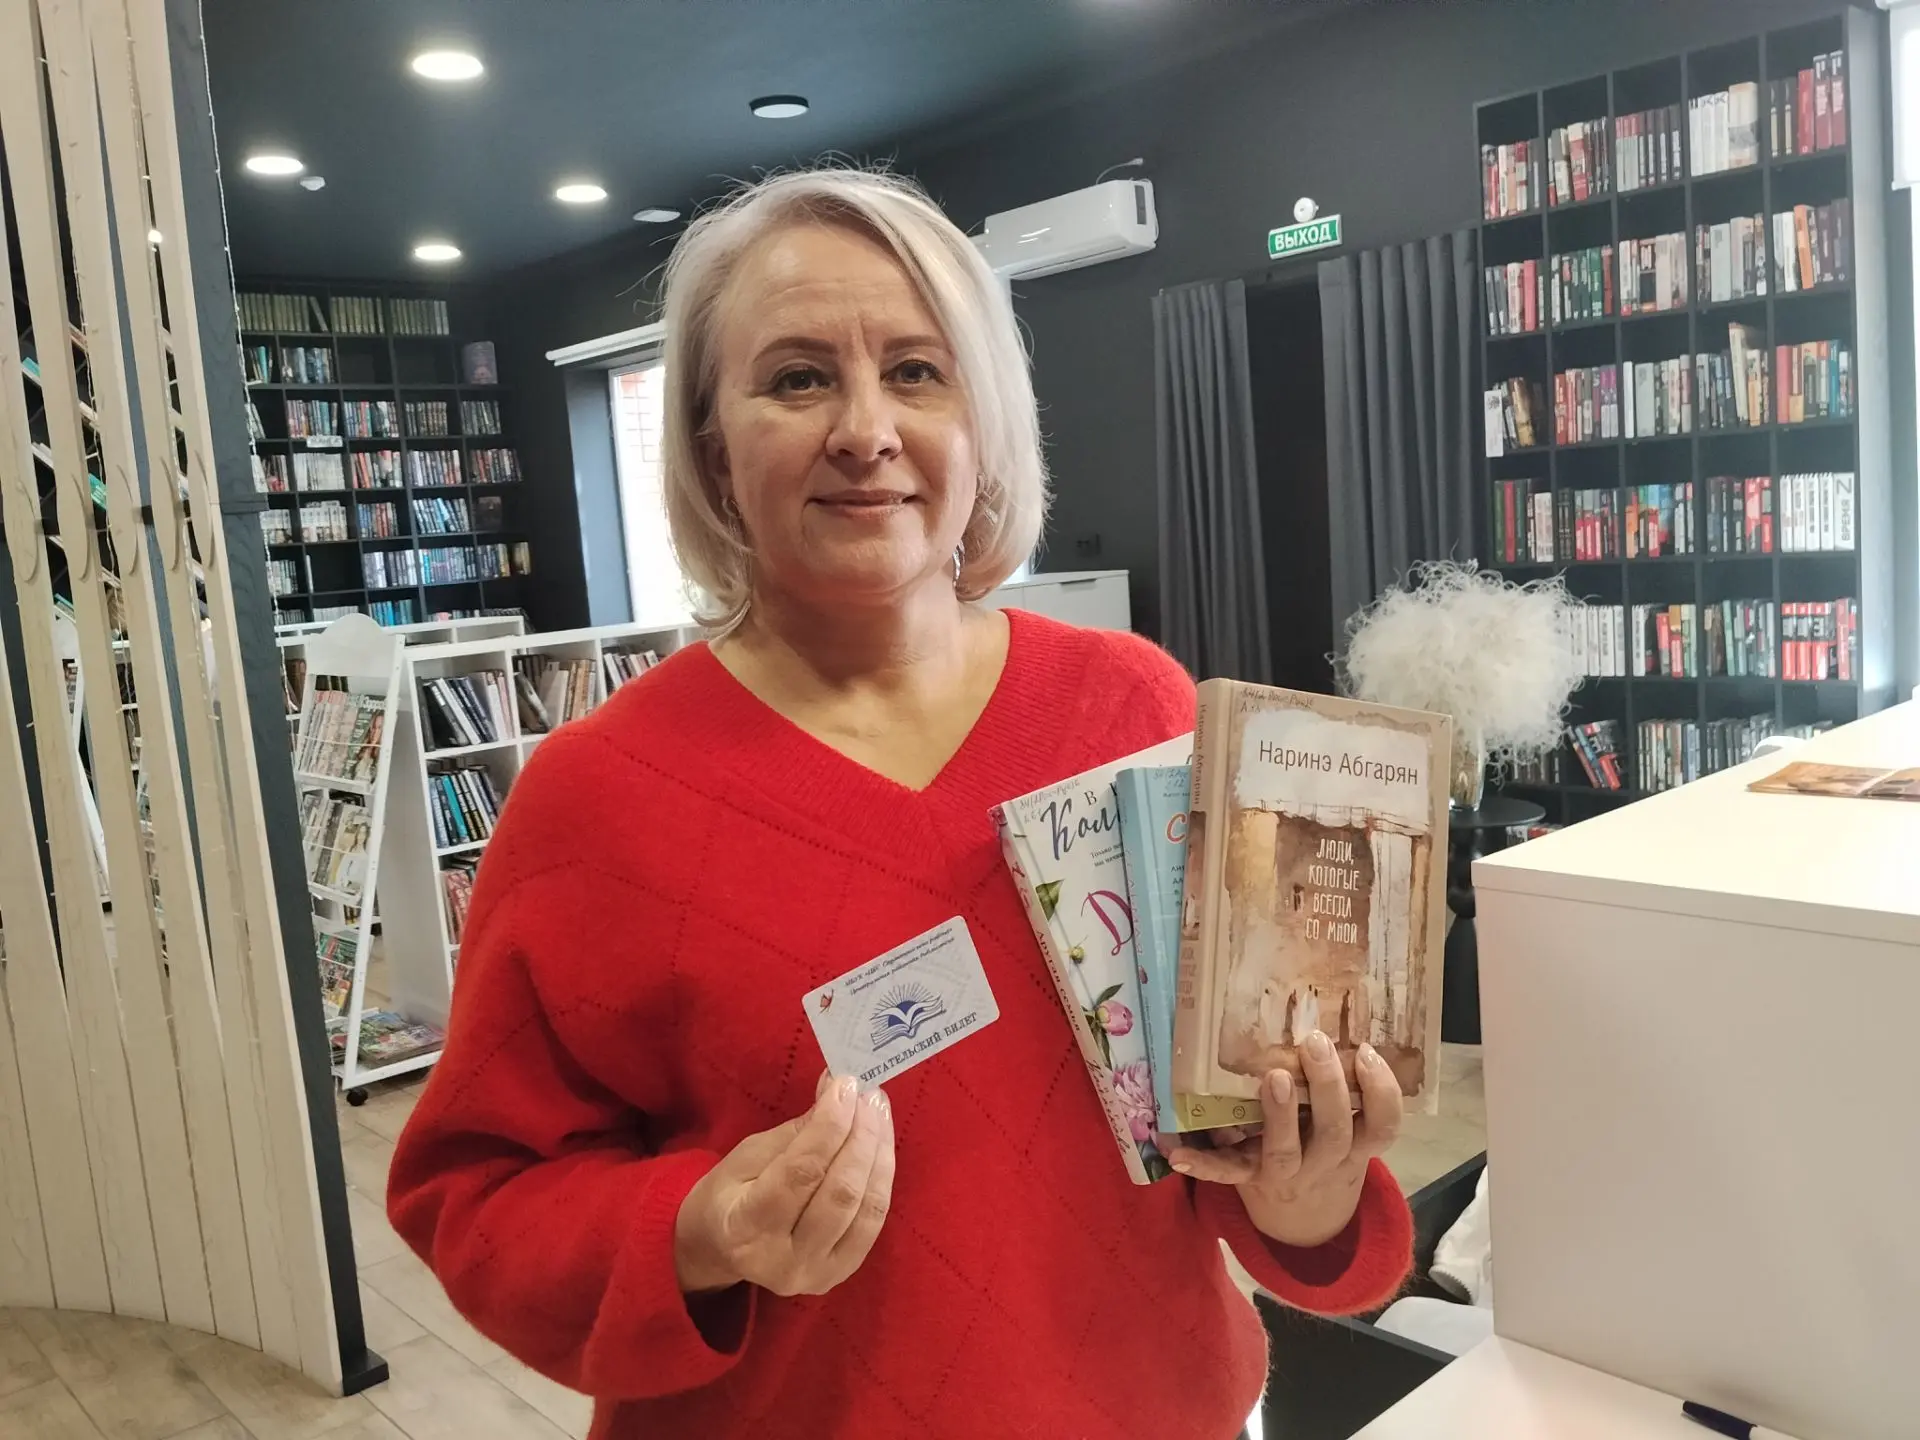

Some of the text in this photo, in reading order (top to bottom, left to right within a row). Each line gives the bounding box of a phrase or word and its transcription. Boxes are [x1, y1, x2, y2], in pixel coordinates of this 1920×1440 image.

[1274, 222, 1332, 251] ВЫХОД
[1259, 739, 1419, 786] Наринэ Абгарян
[1316, 838, 1354, 866] ЛЮДИ,
[1308, 864, 1360, 891] КОТОРЫЕ
[1313, 892, 1353, 918] ВСЕГДА
[1306, 918, 1358, 944] СО МНОЙ
[860, 1011, 978, 1082] ЧИТАТЕЛЬСКИЙ БИЛЕТ
